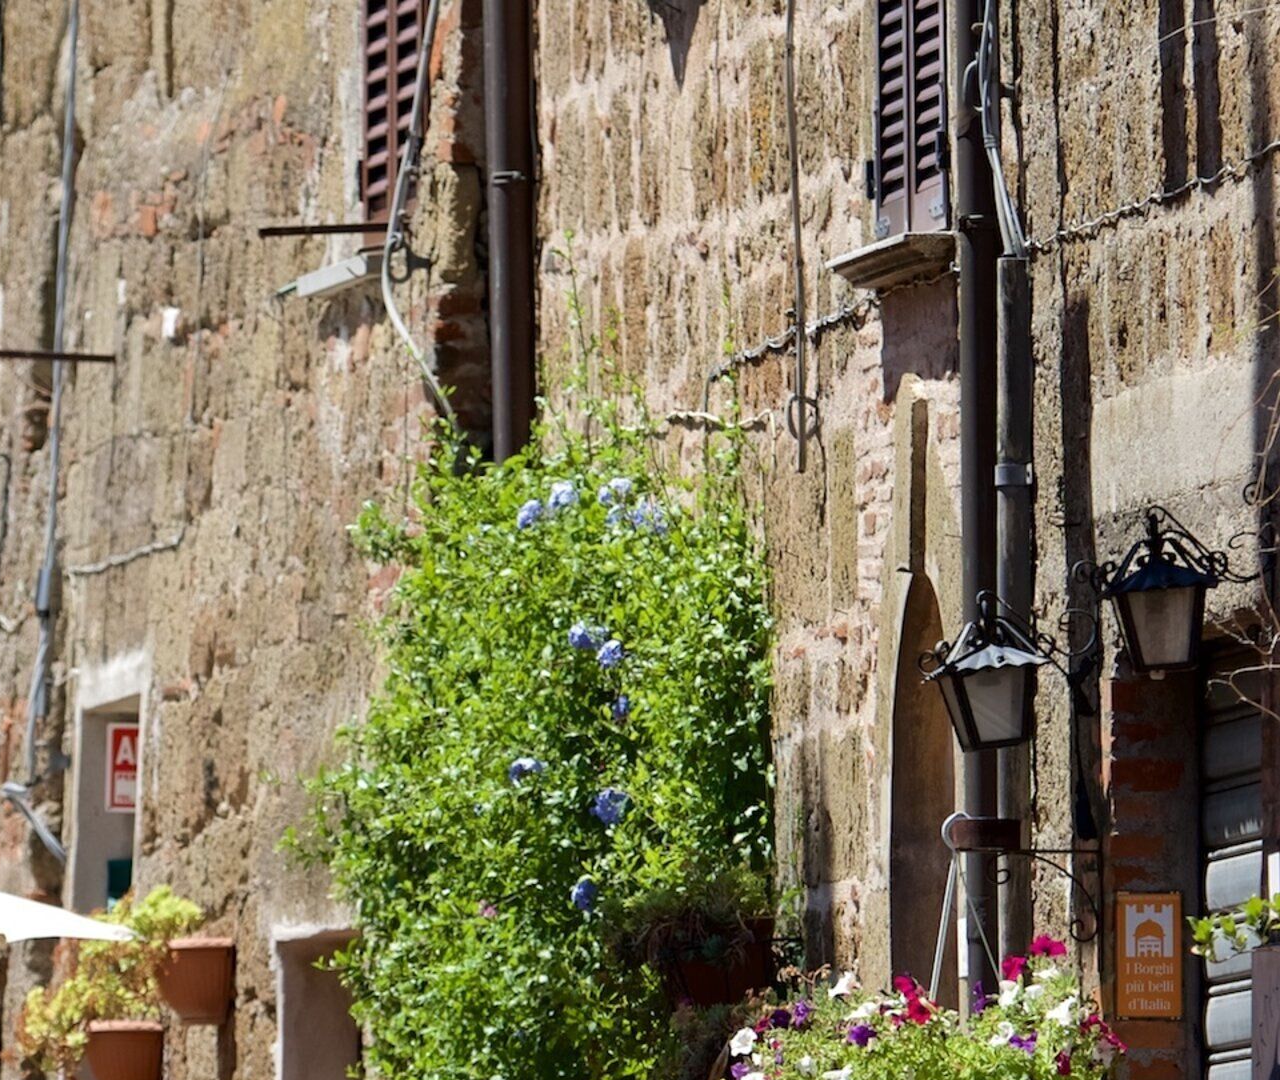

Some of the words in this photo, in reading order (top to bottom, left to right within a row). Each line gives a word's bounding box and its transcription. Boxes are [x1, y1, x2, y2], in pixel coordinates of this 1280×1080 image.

[1134, 962, 1174, 977] Borghi
[1125, 979, 1145, 994] più
[1148, 980, 1175, 993] belli
[1128, 998, 1171, 1010] d'Italia
